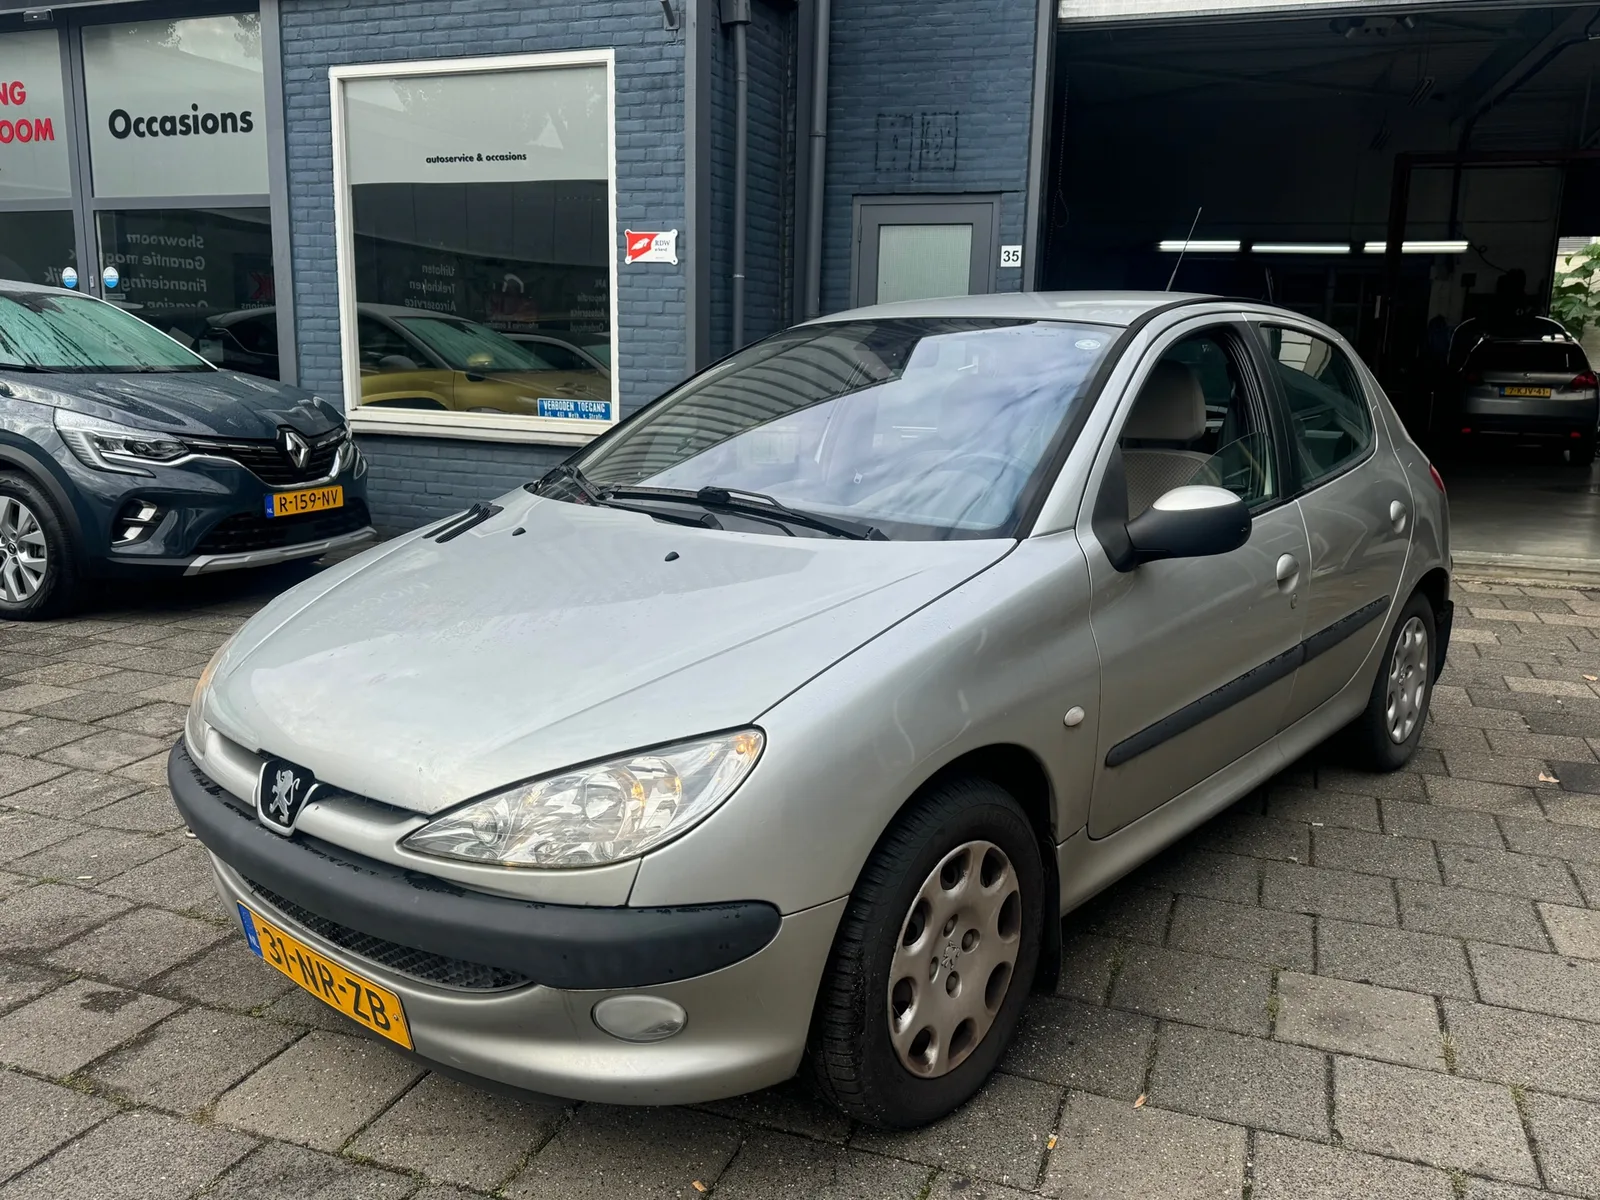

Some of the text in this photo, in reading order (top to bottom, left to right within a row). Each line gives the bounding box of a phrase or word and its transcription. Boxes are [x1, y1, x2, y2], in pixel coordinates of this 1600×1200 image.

[108, 103, 254, 139] Occasions
[426, 152, 527, 164] autoservice & occasions
[1003, 250, 1019, 262] 35
[543, 400, 606, 413] VERBODEN TOEGANG
[279, 489, 338, 513] R-159-NV
[247, 926, 391, 1031] NL 31-NR-ZB
